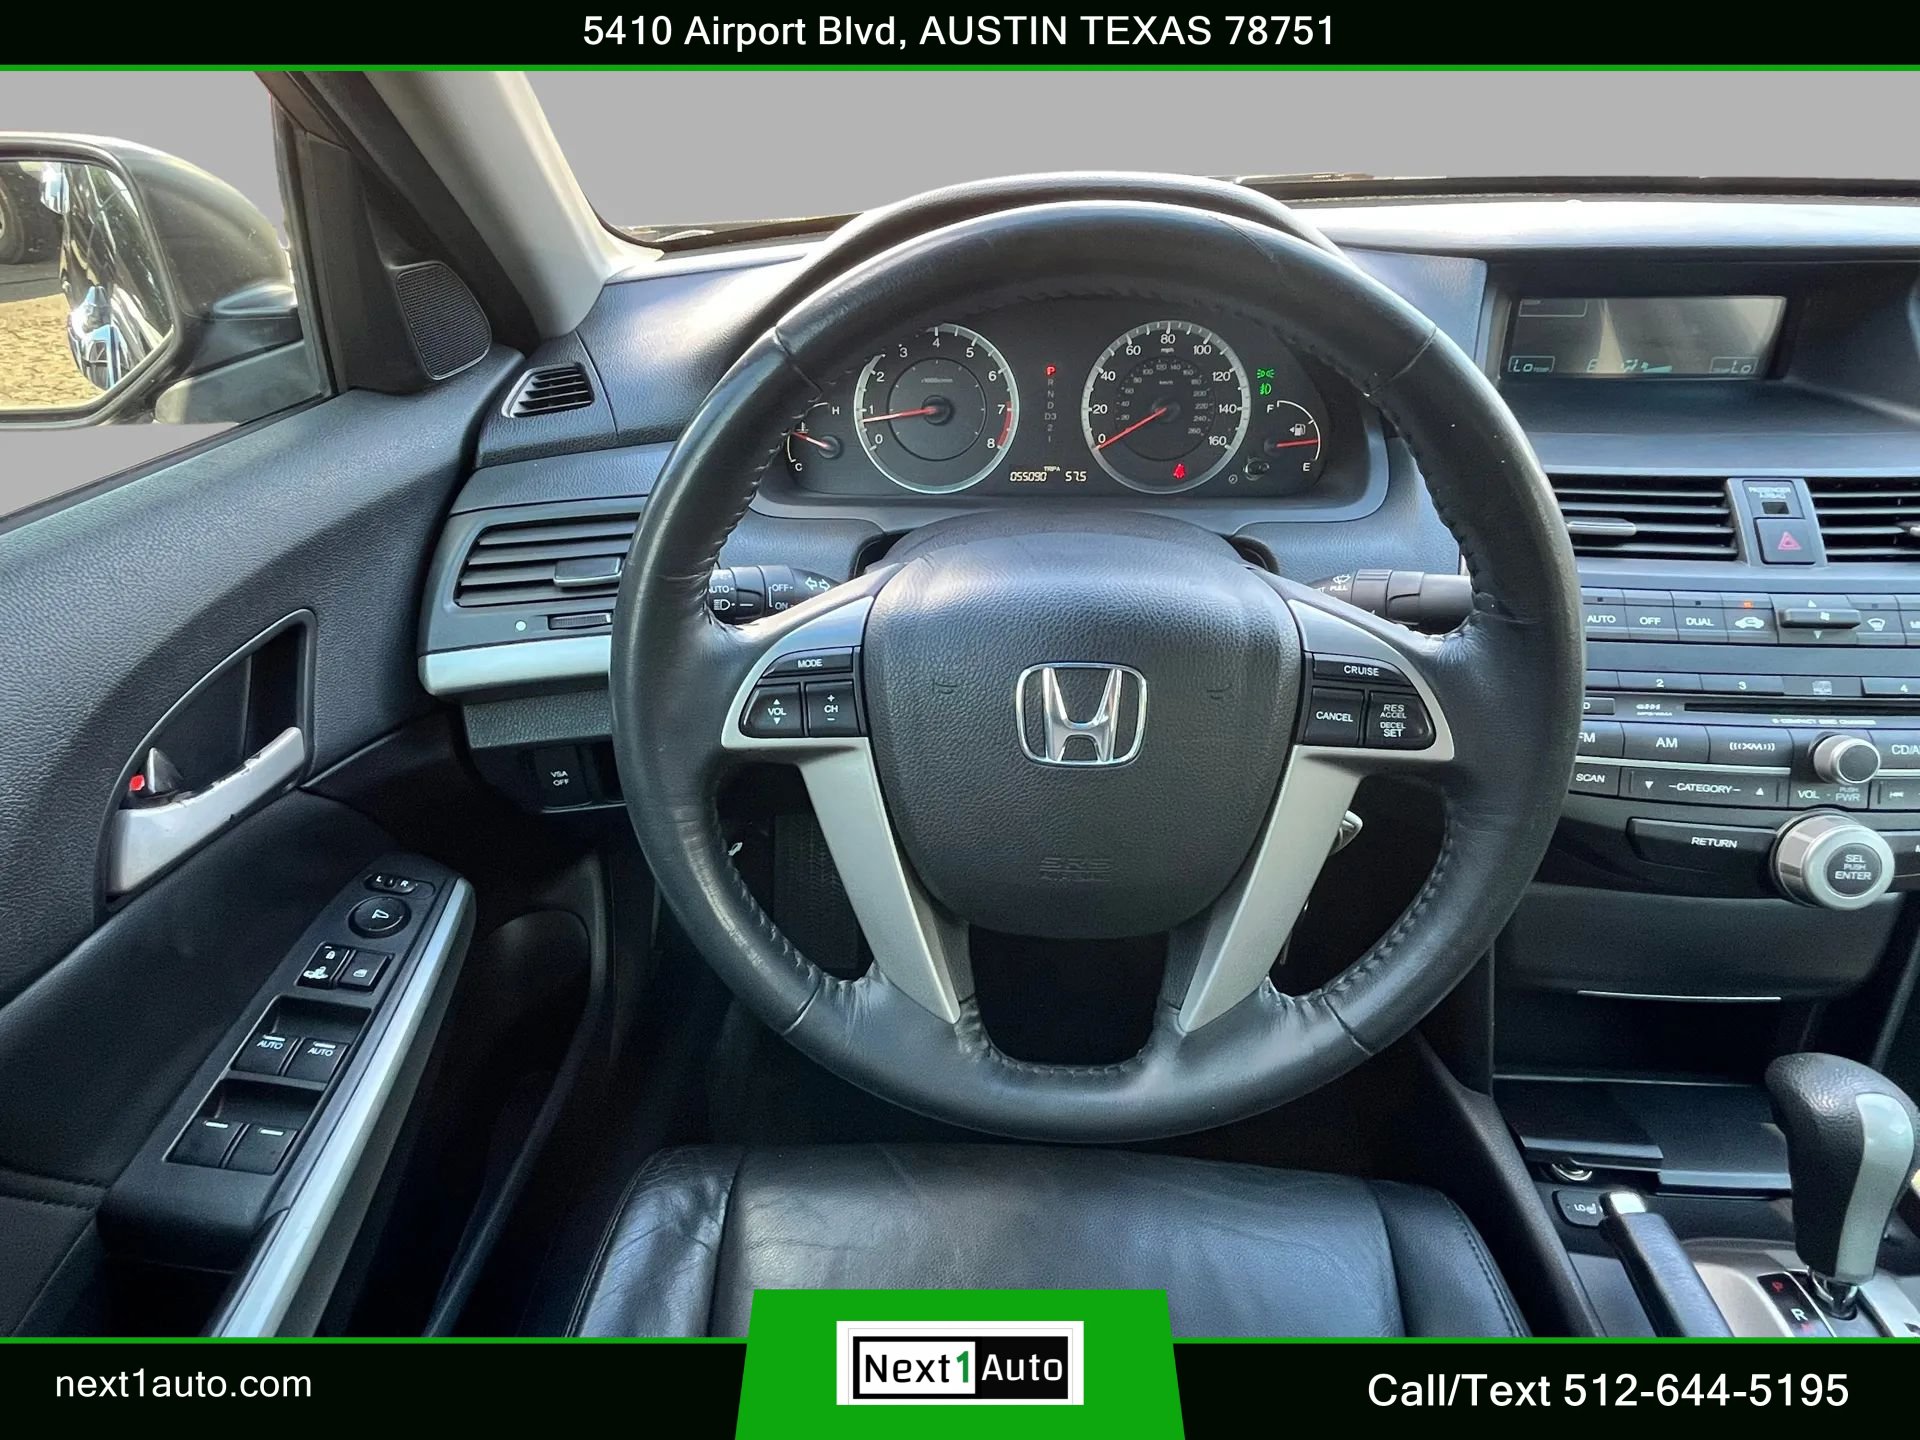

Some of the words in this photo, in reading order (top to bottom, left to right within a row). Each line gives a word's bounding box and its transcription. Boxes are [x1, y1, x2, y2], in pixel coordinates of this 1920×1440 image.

[933, 338, 940, 347] 4
[1160, 334, 1176, 345] 80
[900, 347, 908, 357] 3
[966, 347, 975, 357] 5
[1126, 346, 1141, 355] 60
[1194, 345, 1212, 355] 100
[988, 370, 997, 381] 6
[1047, 367, 1055, 375] P
[876, 371, 885, 382] 2
[1101, 371, 1116, 381] 40
[1212, 372, 1231, 382] 120
[870, 405, 873, 414] 1
[998, 405, 1005, 414] 7
[1093, 404, 1107, 414] 20
[1219, 404, 1237, 413] 140
[875, 434, 882, 446] 0
[987, 438, 995, 448] 8
[1098, 434, 1106, 444] 0
[1208, 436, 1227, 446] 160
[794, 464, 803, 472] C
[1303, 463, 1310, 471] E
[1010, 472, 1048, 482] 055090
[772, 583, 788, 592] OFF
[774, 602, 788, 611] ON
[1587, 615, 1616, 623] AUTO
[1640, 617, 1661, 625] OFF
[1686, 618, 1714, 626] DUAL
[797, 659, 823, 668] MODE
[1344, 664, 1381, 676] CRUISE
[1656, 679, 1663, 687] 2
[824, 705, 838, 713] CH
[1384, 705, 1404, 713] RES
[1316, 712, 1353, 722] CANCEL
[1379, 722, 1406, 730] DECEL
[1383, 730, 1402, 738] SET
[1578, 732, 1596, 743] FM
[1656, 737, 1677, 747] AM
[1890, 743, 1920, 756] CD/A
[1576, 774, 1605, 782] SCAN
[1798, 790, 1819, 798] VOL
[1835, 792, 1860, 802] PWR
[1692, 837, 1737, 848] RETURN
[1843, 863, 1867, 872] PUSH
[376, 874, 383, 882] L
[1835, 871, 1871, 880] ENTER
[256, 1040, 284, 1050] AUTO
[307, 1047, 334, 1057] AUTO
[1573, 1204, 1586, 1212] LO
[1791, 1309, 1808, 1321] R
